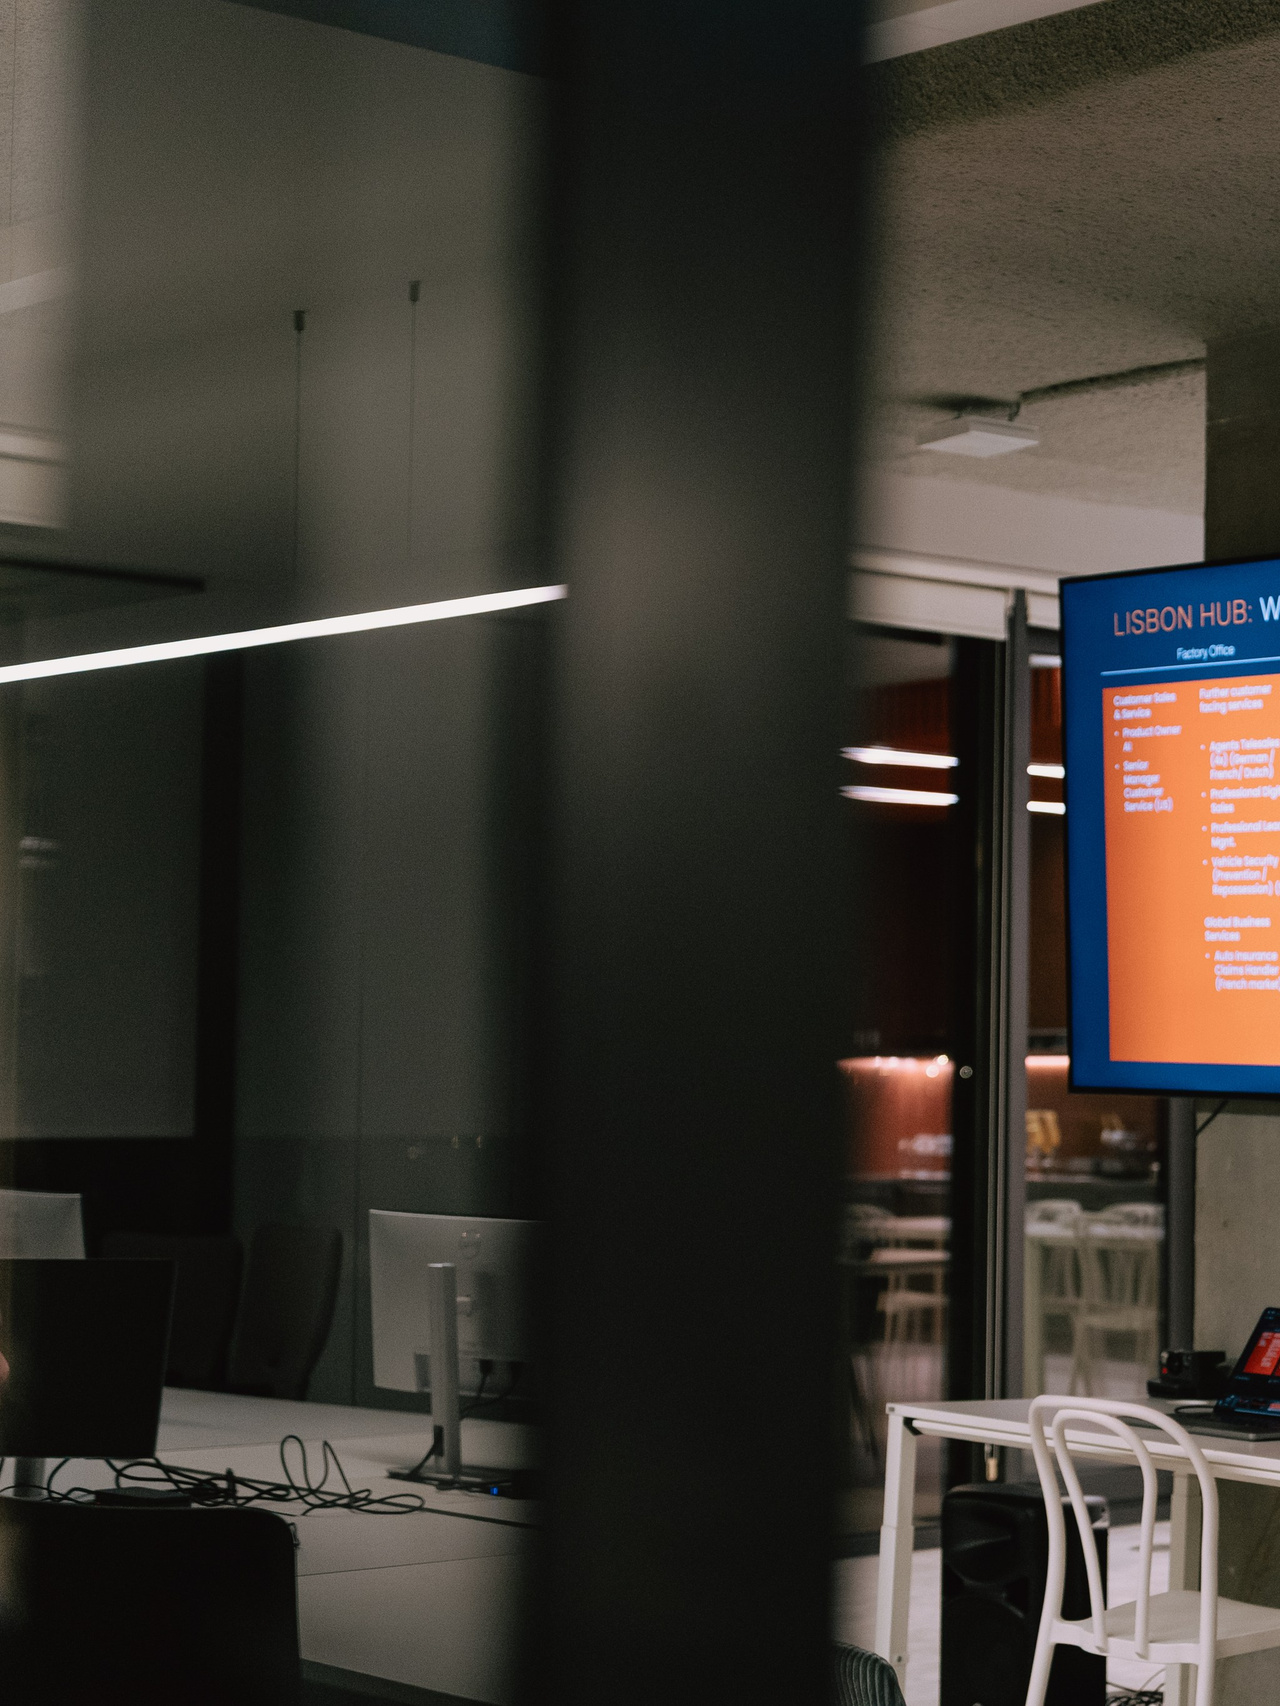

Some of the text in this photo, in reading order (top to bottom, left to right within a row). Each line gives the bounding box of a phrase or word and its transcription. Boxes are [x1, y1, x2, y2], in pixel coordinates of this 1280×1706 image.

[1114, 604, 1192, 636] LISBON
[1200, 599, 1252, 627] HUB:
[1176, 644, 1235, 660] Factory Office
[1200, 684, 1272, 699] Further customer
[1113, 692, 1176, 706] Customer Sales
[1200, 698, 1263, 715] facing services
[1114, 708, 1151, 720] & Service
[1122, 725, 1182, 738] Product Owner
[1210, 737, 1280, 753] Agents Telesales
[1230, 751, 1268, 766] (German
[1123, 760, 1149, 771] Senior
[1123, 774, 1160, 787] Manager
[1124, 787, 1164, 799] Customer
[1210, 786, 1261, 799] Professional
[1124, 800, 1153, 812] Service
[1211, 802, 1234, 814] Sales
[1211, 820, 1261, 833] Professional
[1211, 854, 1279, 869] Vehicle Security
[1212, 867, 1261, 883] (Prevention
[1204, 916, 1271, 928] Global Business
[1205, 929, 1240, 941] Services
[1214, 951, 1233, 961] Auto
[1215, 964, 1279, 975] Claims Handler
[1215, 976, 1247, 992] (French
